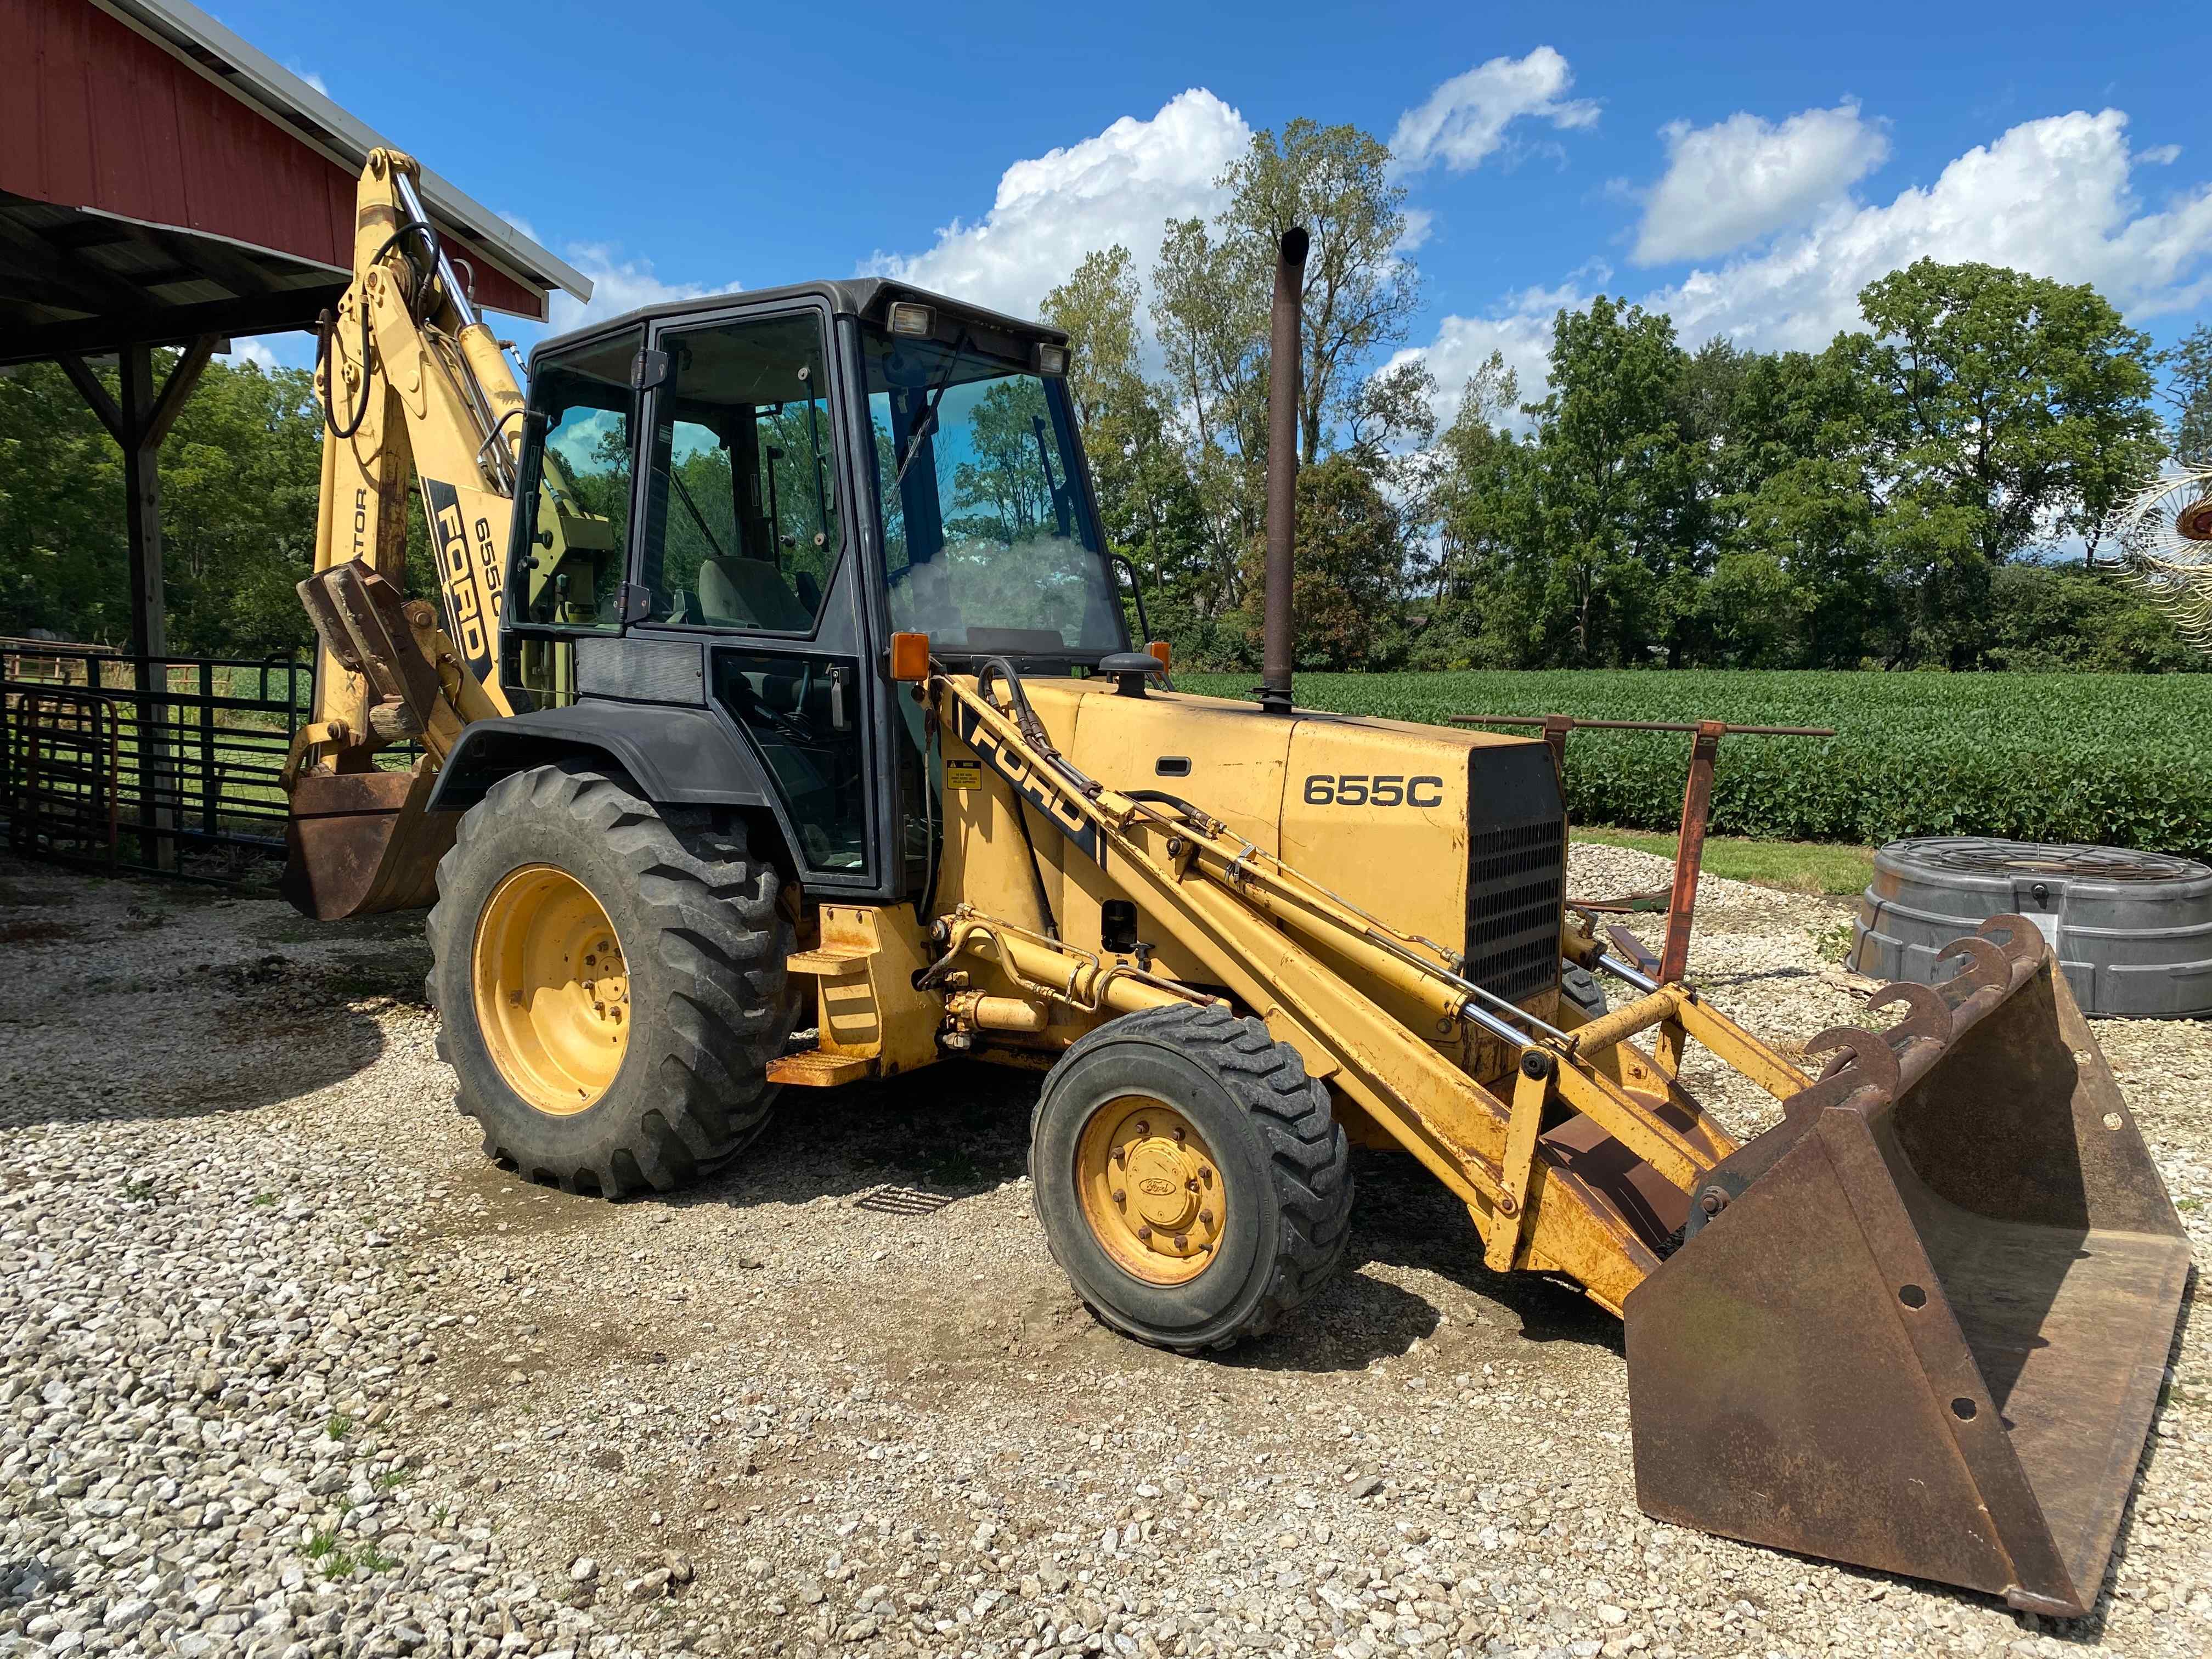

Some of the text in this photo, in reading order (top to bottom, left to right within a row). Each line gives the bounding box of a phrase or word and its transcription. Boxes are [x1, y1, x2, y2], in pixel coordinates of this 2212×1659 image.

[438, 504, 485, 660] FORD
[970, 718, 1088, 832] FORD
[1304, 775, 1443, 807] 655C
[1146, 1180, 1170, 1193] Ford
